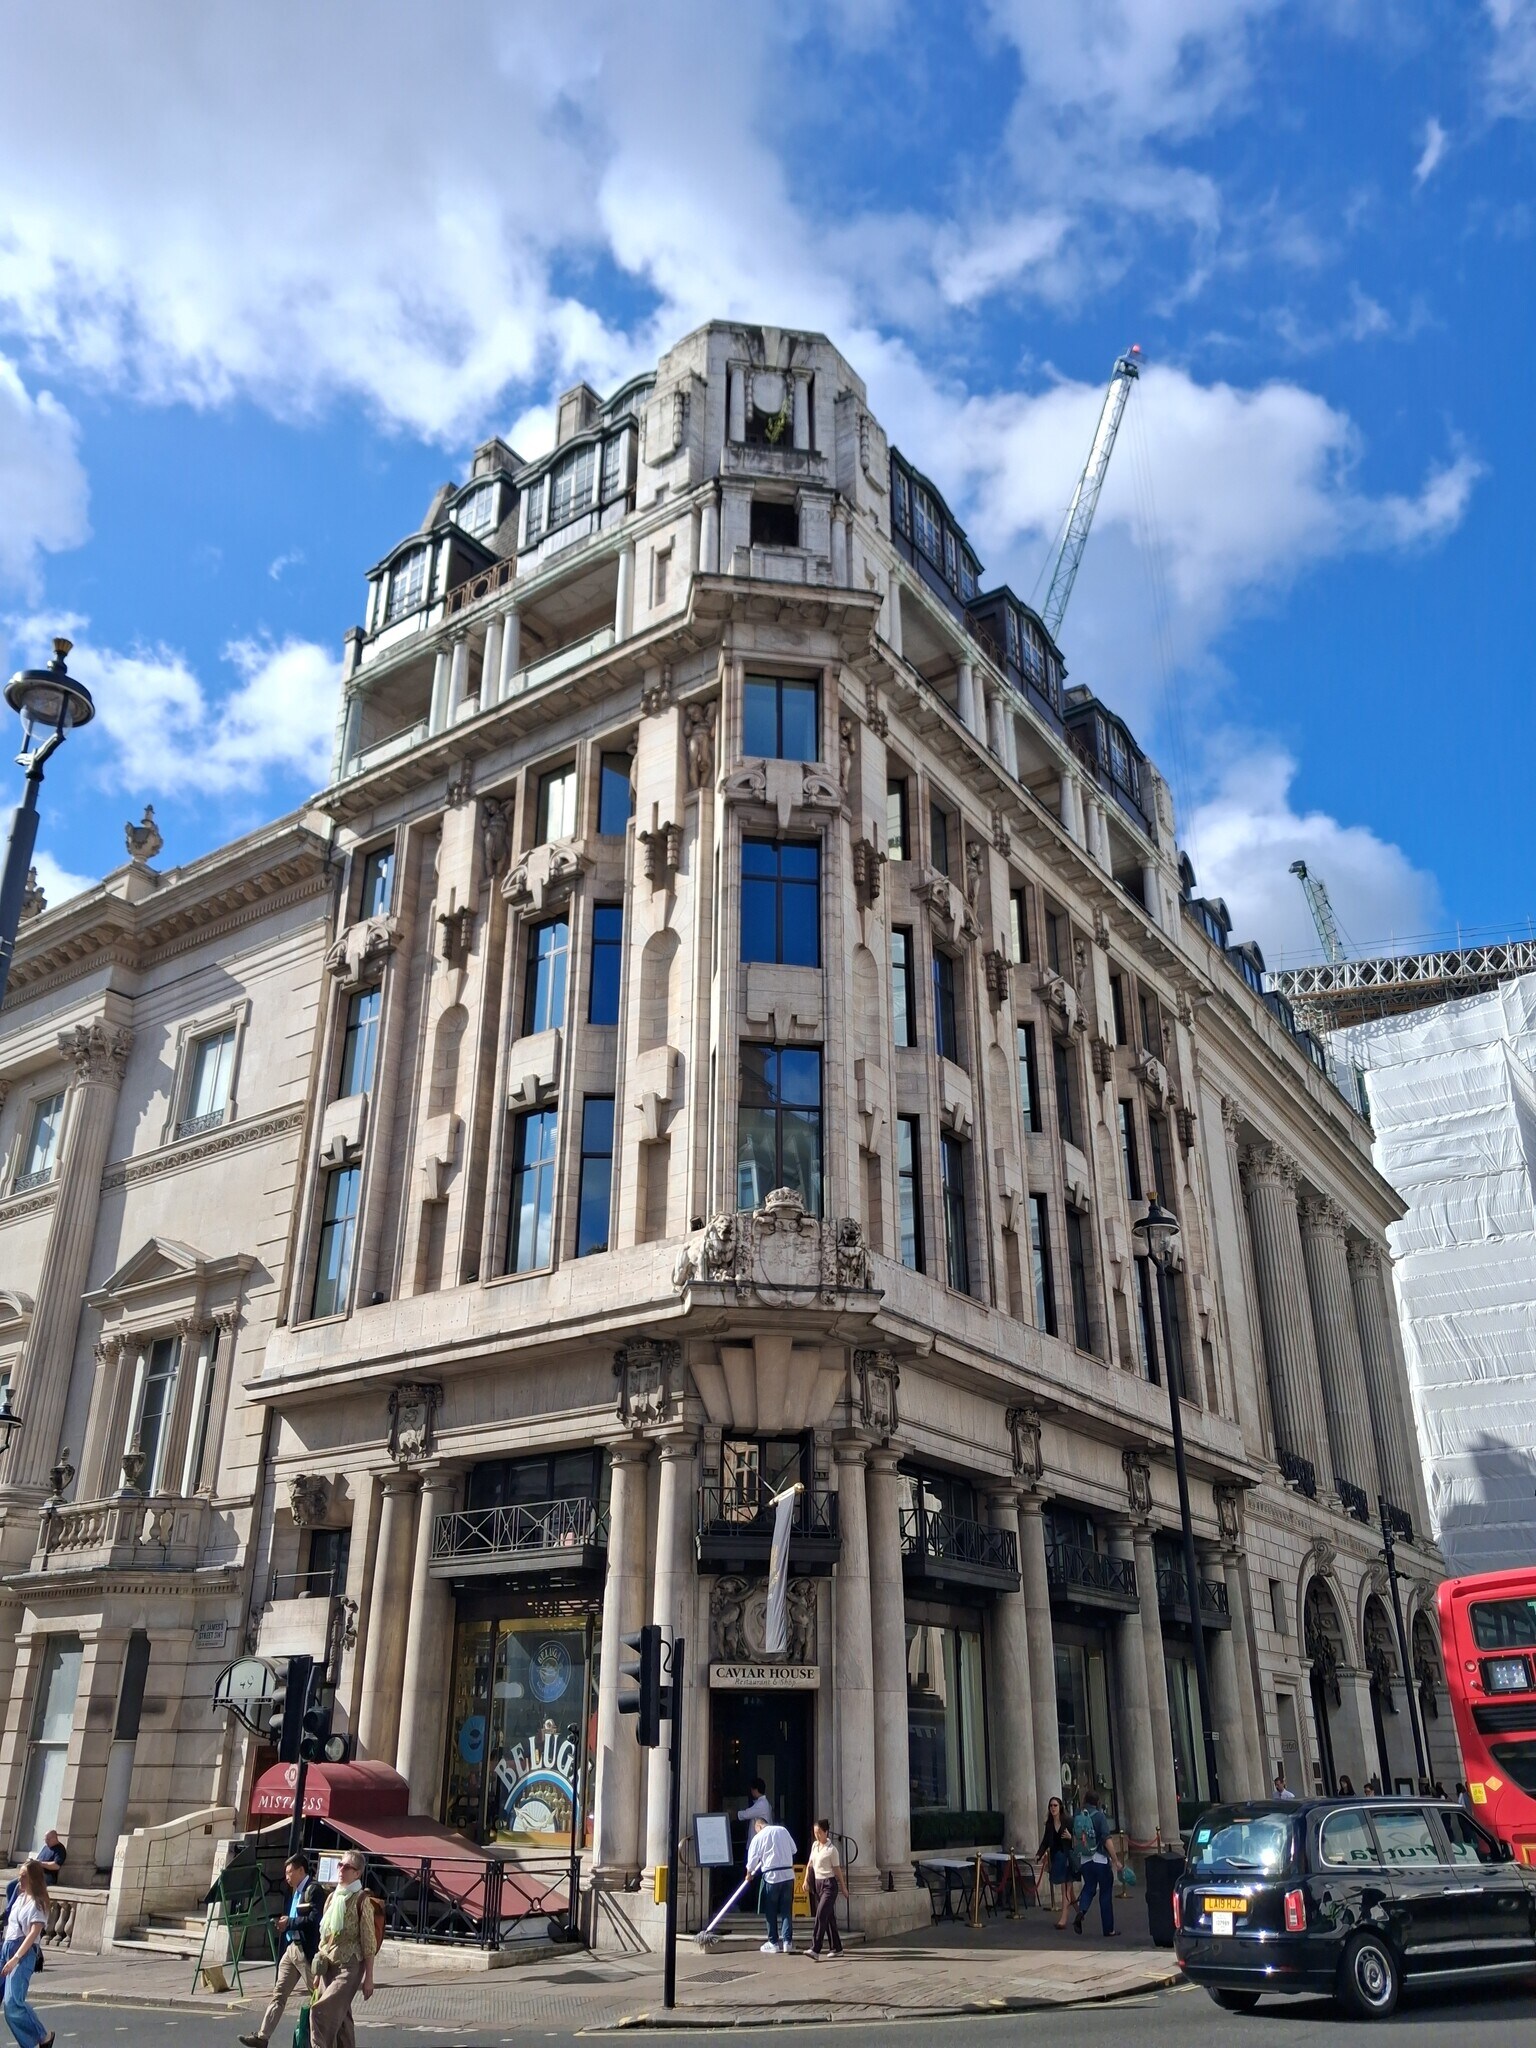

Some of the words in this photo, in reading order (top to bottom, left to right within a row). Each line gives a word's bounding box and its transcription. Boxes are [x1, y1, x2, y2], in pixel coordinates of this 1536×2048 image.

[716, 1667, 765, 1678] CAVIAR
[769, 1668, 815, 1679] HOUSE
[734, 1678, 770, 1686] Restaurant
[780, 1678, 797, 1688] Shop
[1226, 1898, 1242, 1909] HJZ
